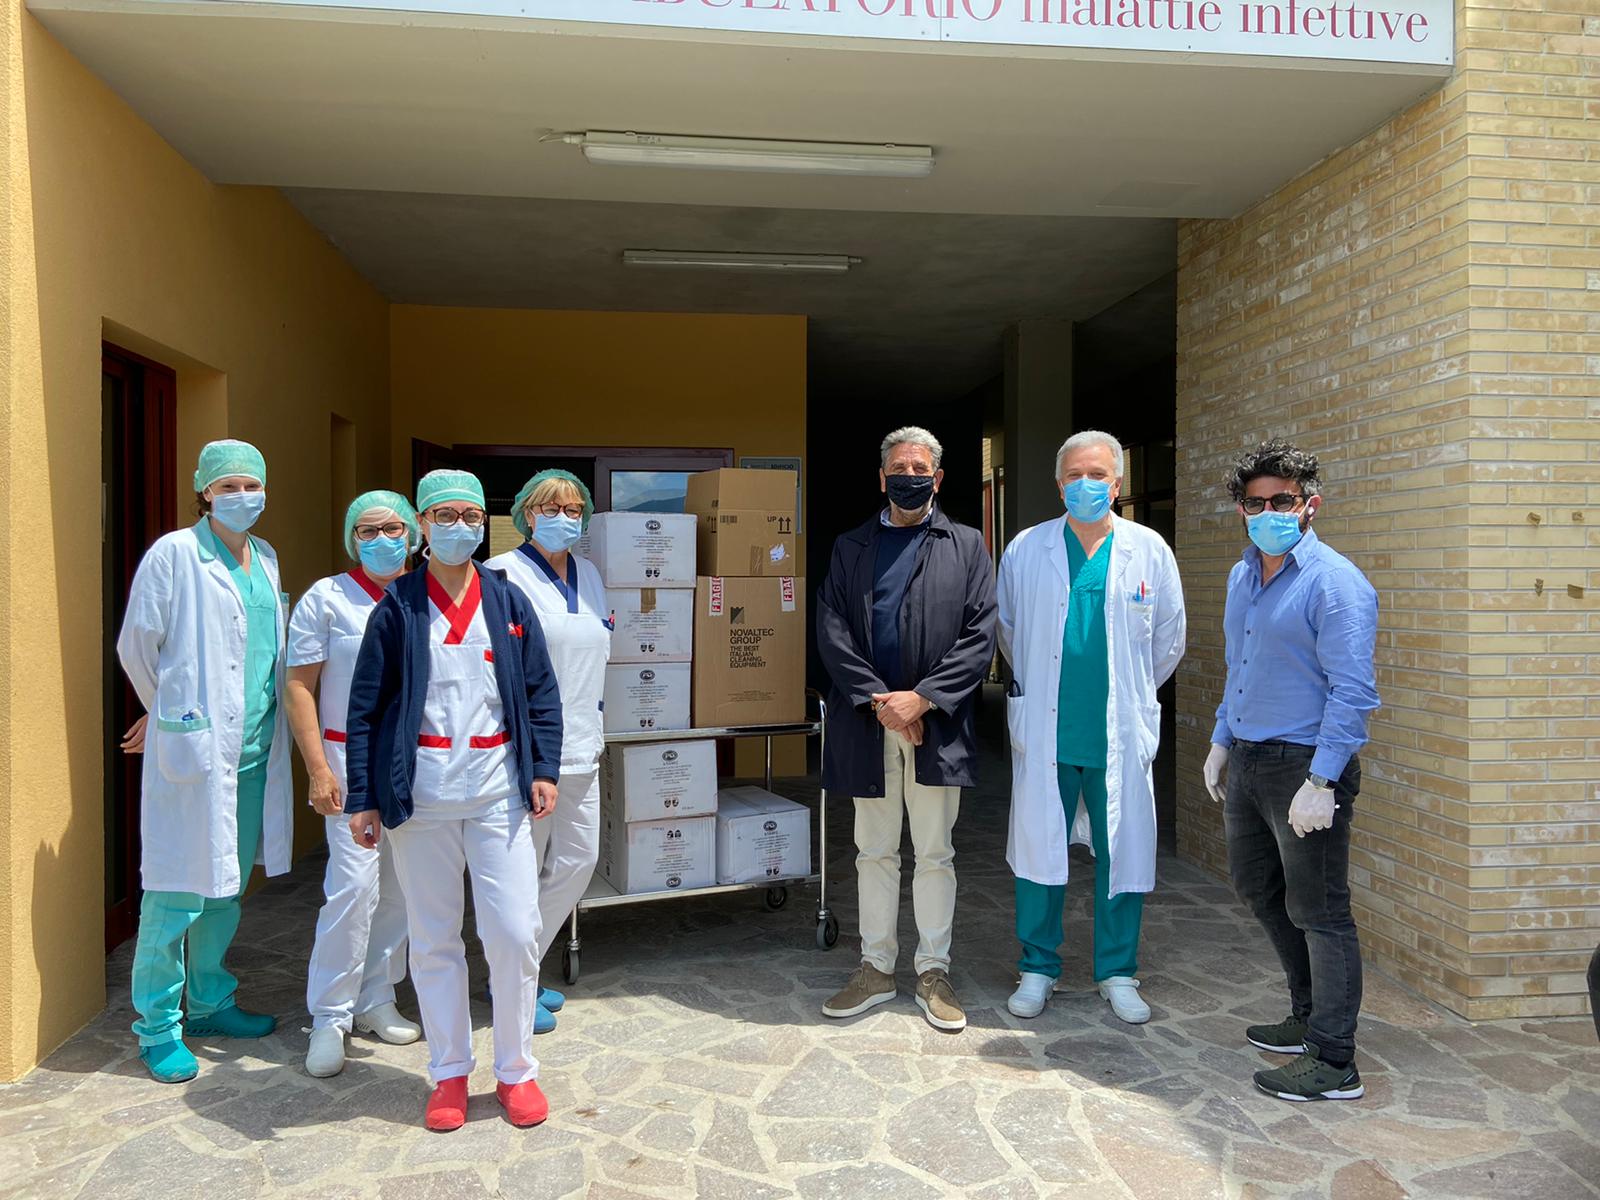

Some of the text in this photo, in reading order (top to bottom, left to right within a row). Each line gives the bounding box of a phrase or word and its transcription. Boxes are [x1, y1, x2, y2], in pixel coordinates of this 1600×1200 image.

[1238, 0, 1430, 43] infettive
[767, 515, 777, 523] UP
[730, 628, 775, 637] NOVALTEC
[730, 636, 762, 645] GROUP
